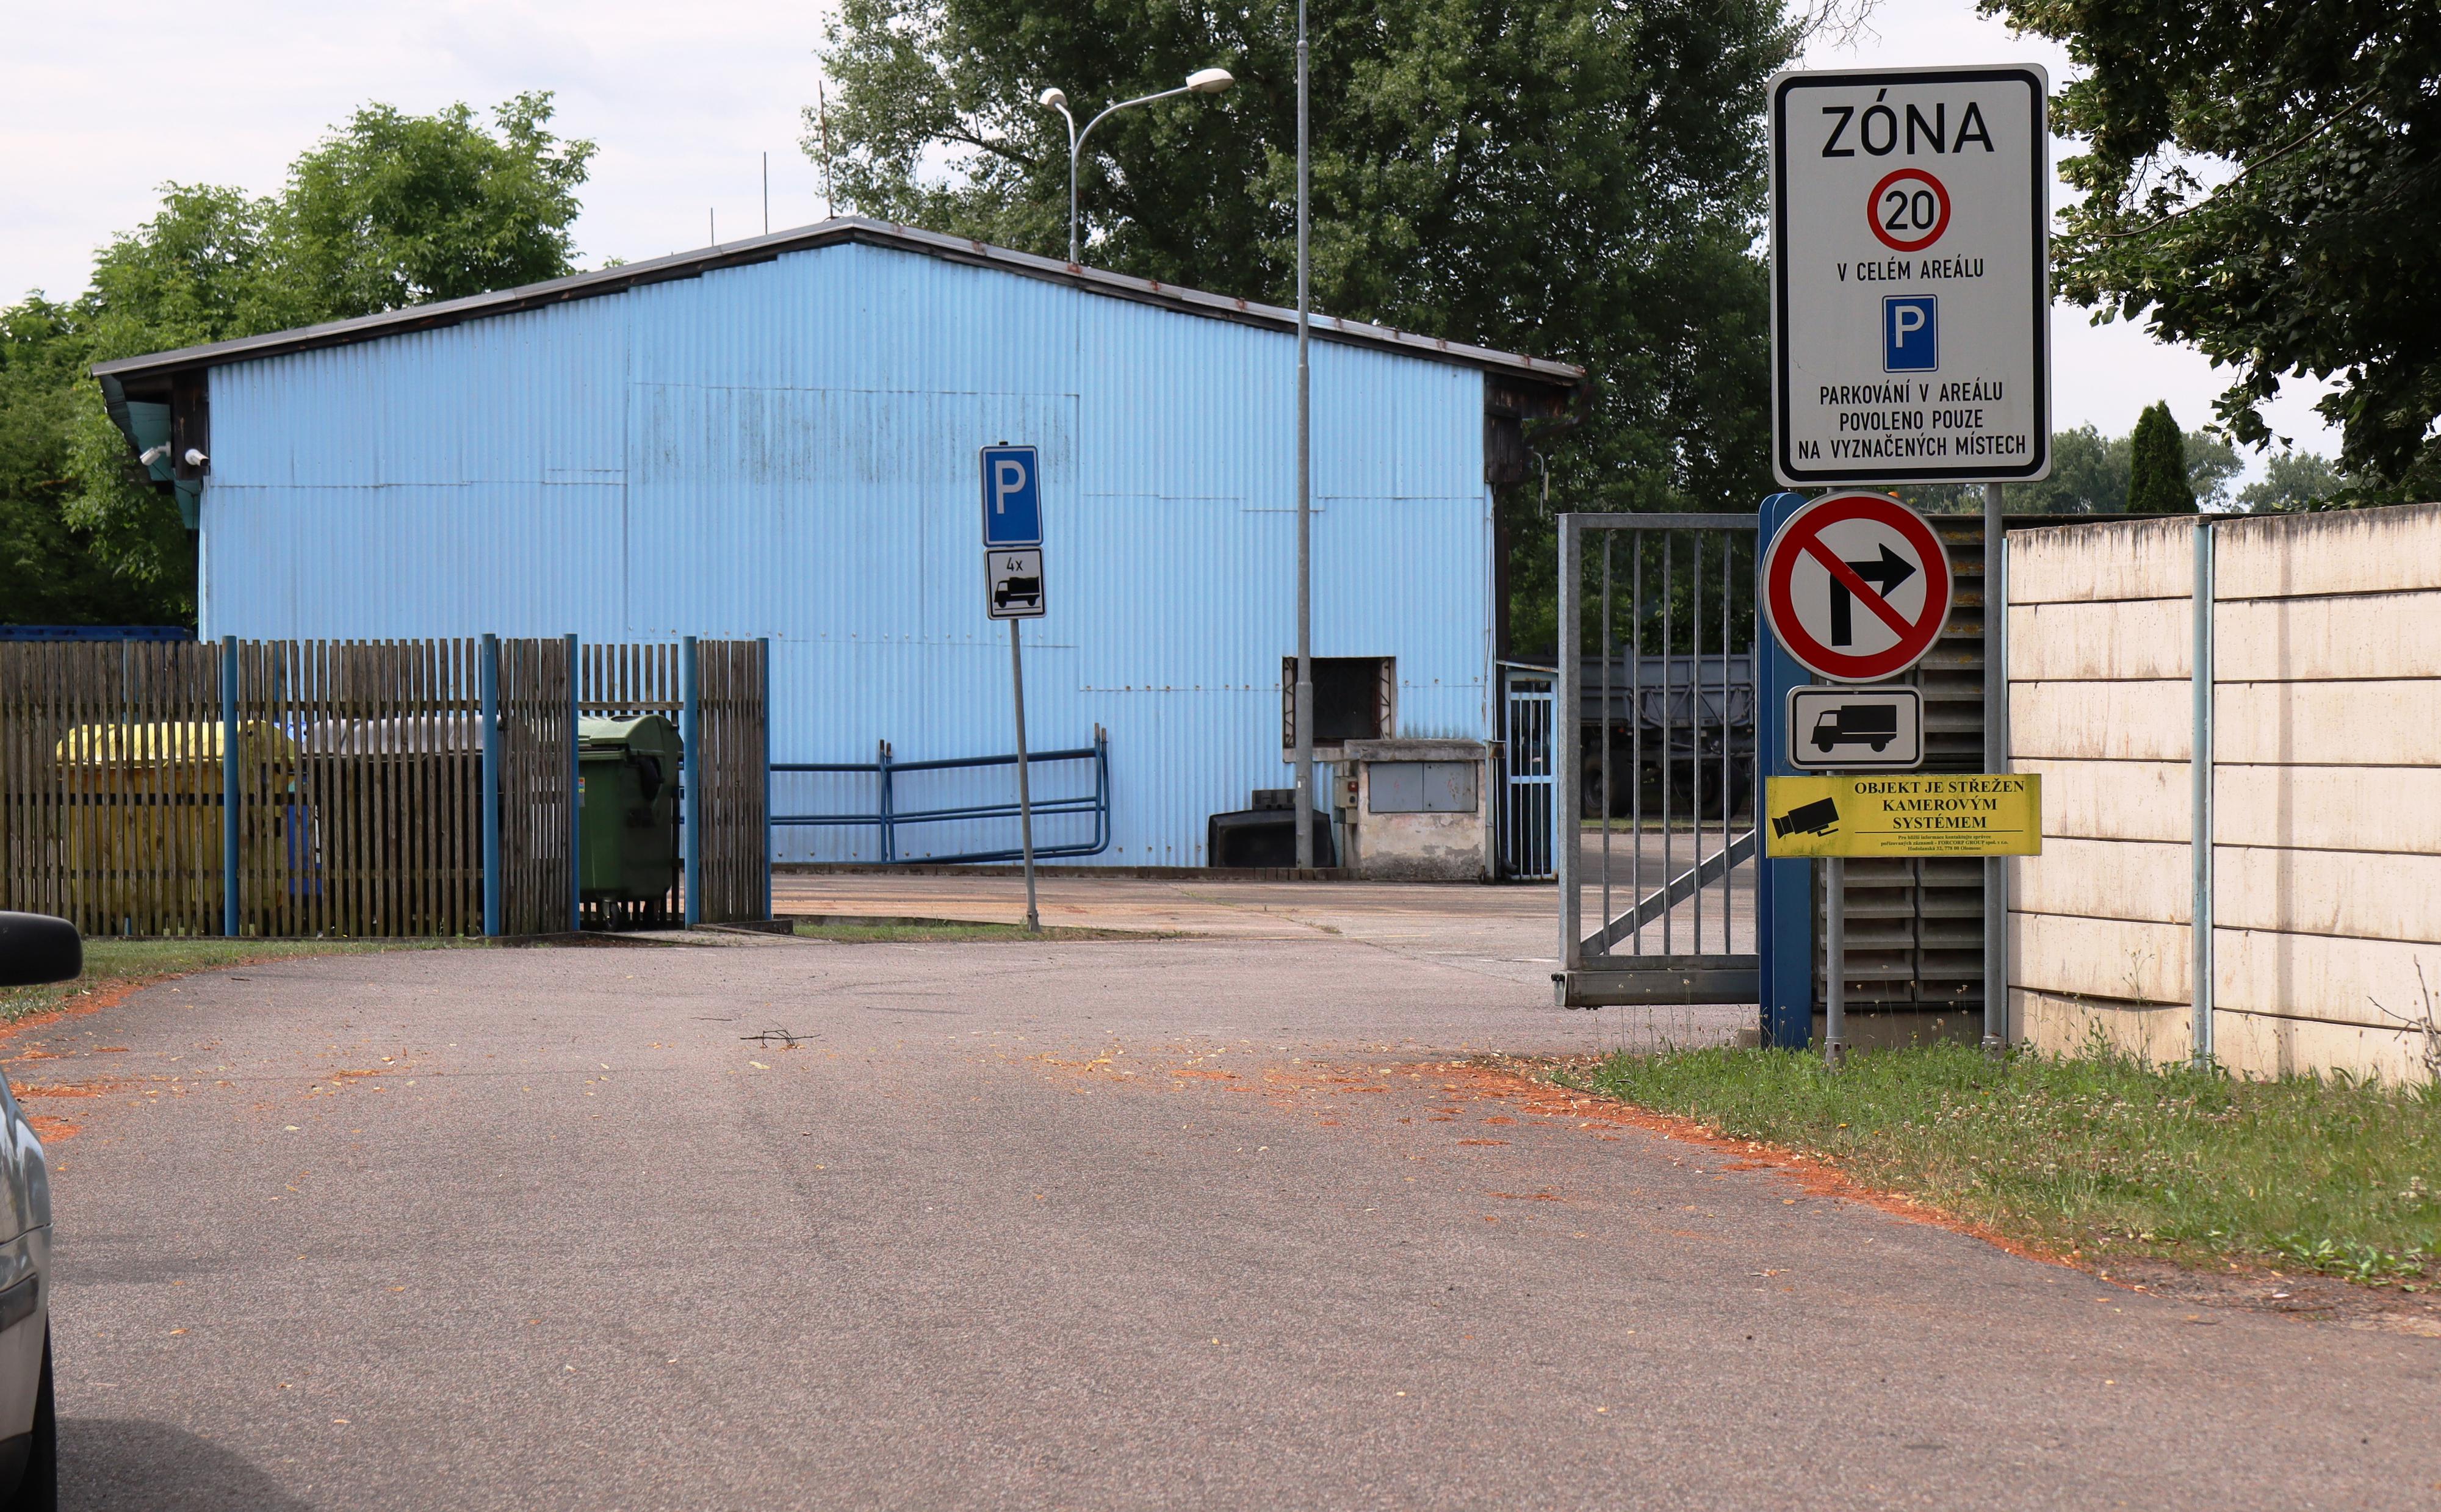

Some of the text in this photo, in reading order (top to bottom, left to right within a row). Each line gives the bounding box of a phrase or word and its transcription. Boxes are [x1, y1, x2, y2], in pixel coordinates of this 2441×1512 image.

[1822, 88, 1994, 157] ZÓNA
[1885, 190, 1934, 229] 20
[1837, 254, 1984, 281] V CELÉM AREÁLU
[1895, 306, 1925, 348] P
[1820, 377, 2002, 405] PARKOVÁNÍ V AREÁLU
[1840, 409, 1983, 431] POVOLENO POUZE
[1798, 431, 2026, 459] NA VYZNAČENÝCH MÍSTECH
[995, 460, 1026, 514] P
[1855, 778, 2024, 794] OBJEKT JE STŘEŽEN
[1883, 796, 1997, 812] KAMEROVÝM
[1893, 814, 1986, 829] SYSTÉMEM
